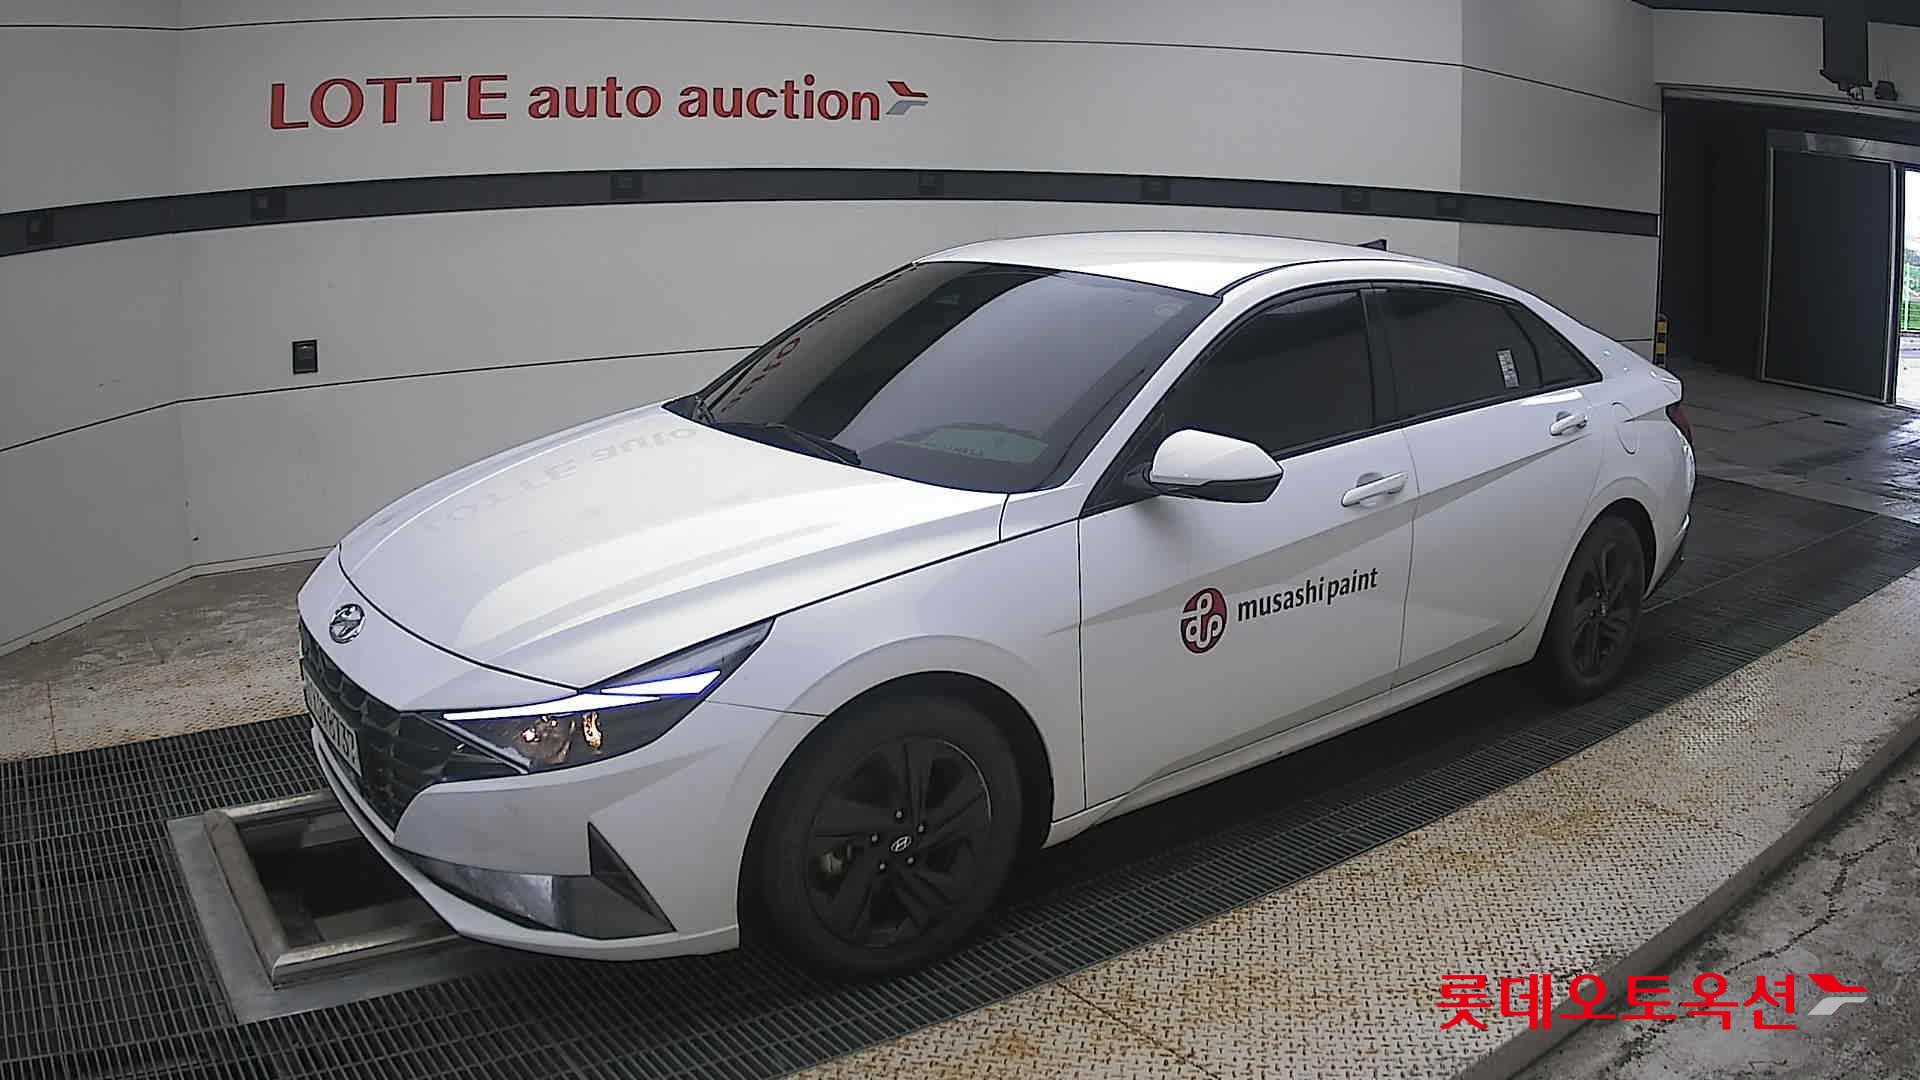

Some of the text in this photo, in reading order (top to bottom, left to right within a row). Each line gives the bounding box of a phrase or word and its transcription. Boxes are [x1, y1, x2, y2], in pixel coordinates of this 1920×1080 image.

[270, 74, 881, 130] LOTTE auto auction
[1237, 567, 1379, 622] musashi paint
